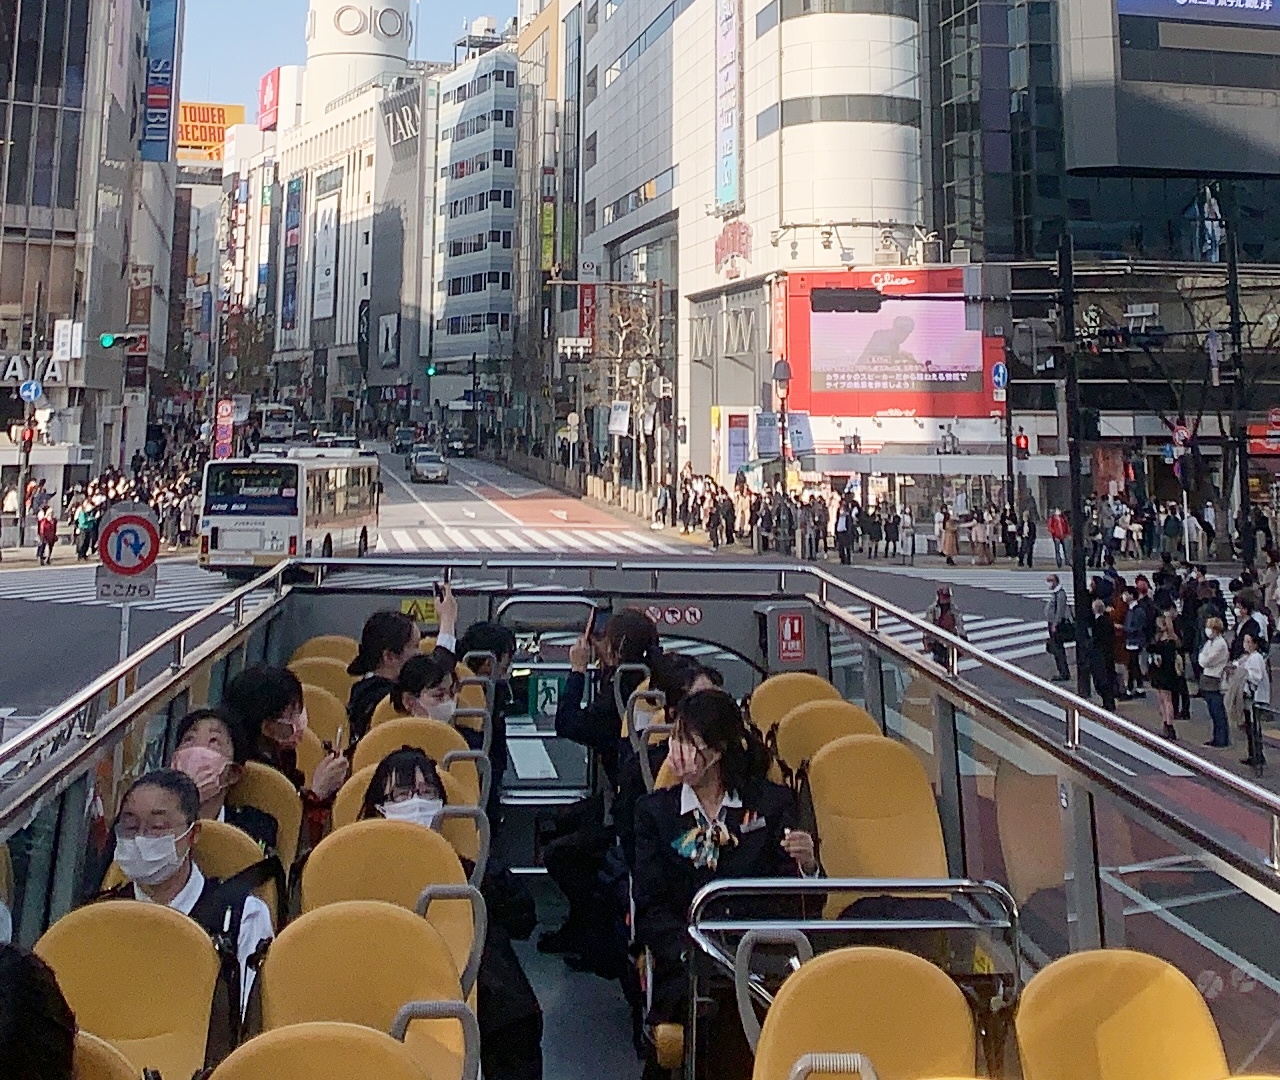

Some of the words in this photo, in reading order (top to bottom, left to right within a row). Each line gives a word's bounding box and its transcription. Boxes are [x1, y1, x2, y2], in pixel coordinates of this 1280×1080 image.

[146, 59, 171, 141] SEIBU
[182, 106, 226, 124] TOWER
[384, 103, 420, 146] ZARA
[871, 273, 915, 291] Glico
[100, 583, 151, 597] ここから
